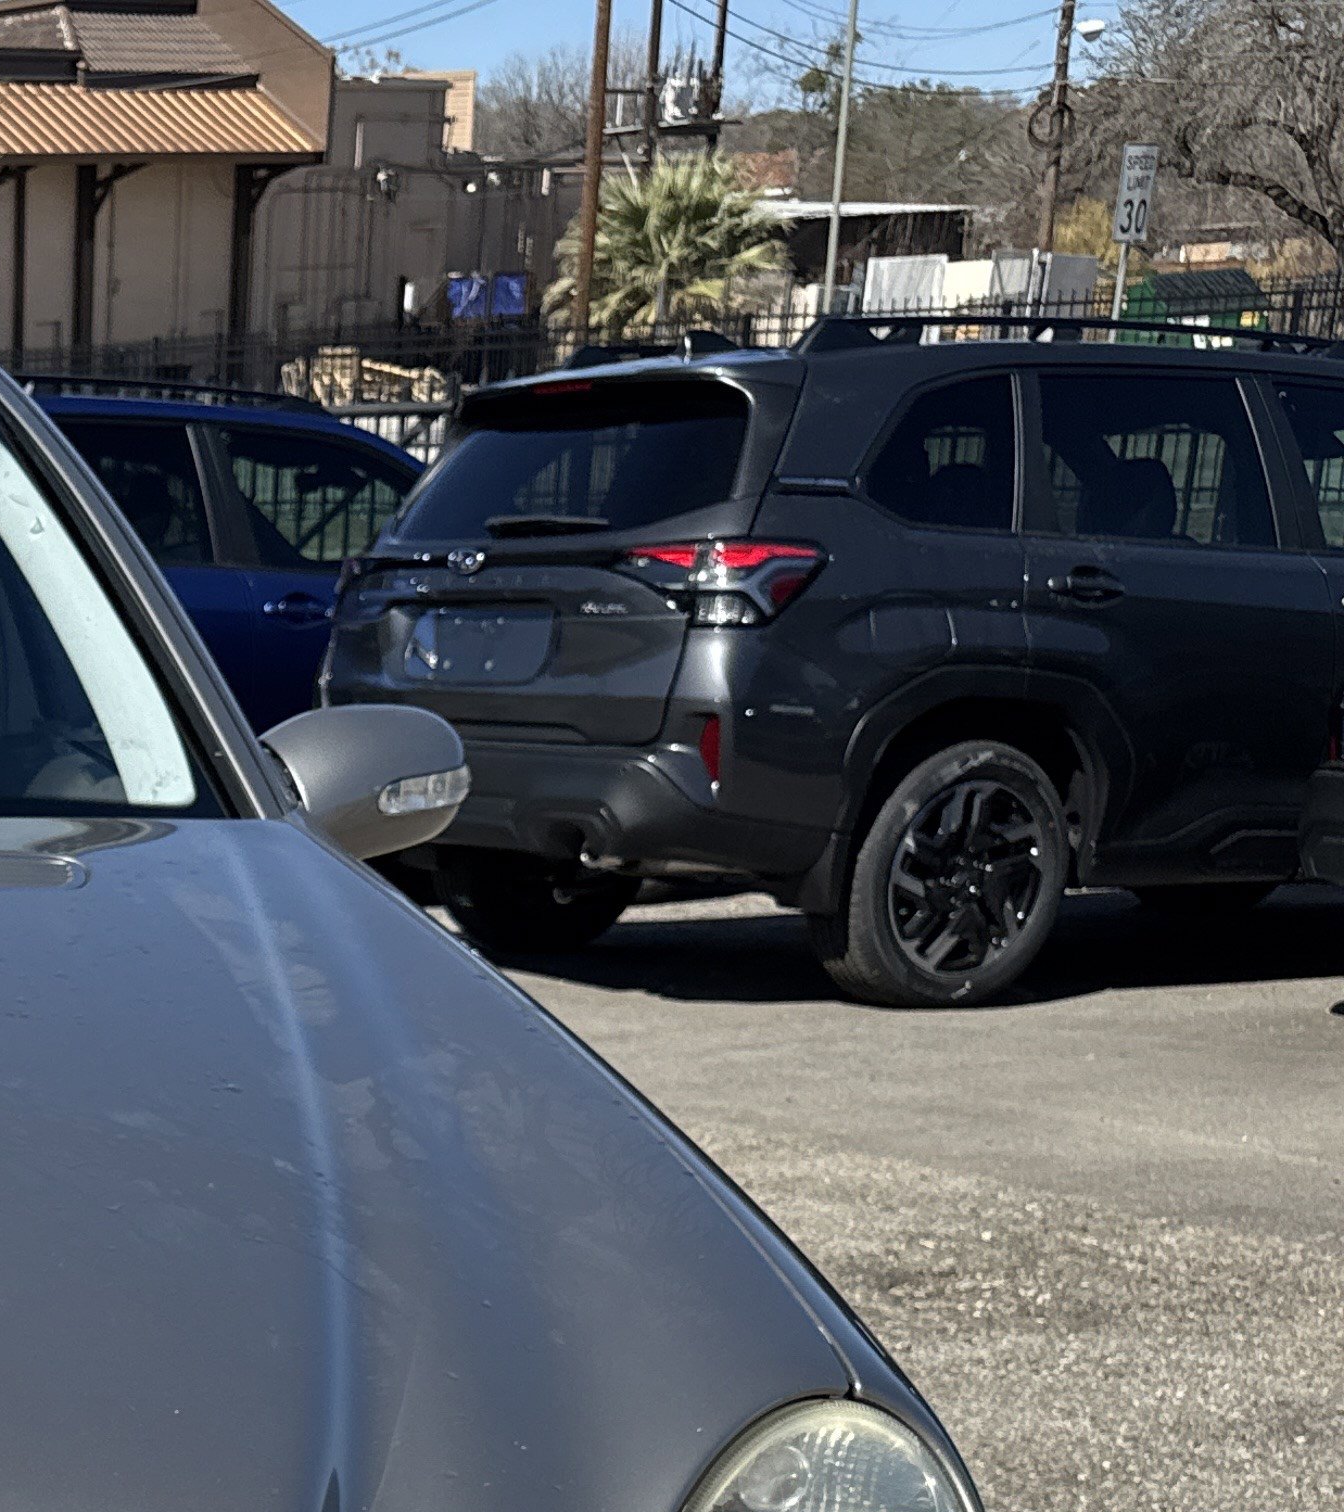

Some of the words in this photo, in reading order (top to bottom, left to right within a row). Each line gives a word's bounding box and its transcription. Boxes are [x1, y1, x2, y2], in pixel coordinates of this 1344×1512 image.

[1127, 155, 1156, 171] SPEED
[1126, 175, 1152, 191] LIMIT
[1119, 198, 1148, 234] 30
